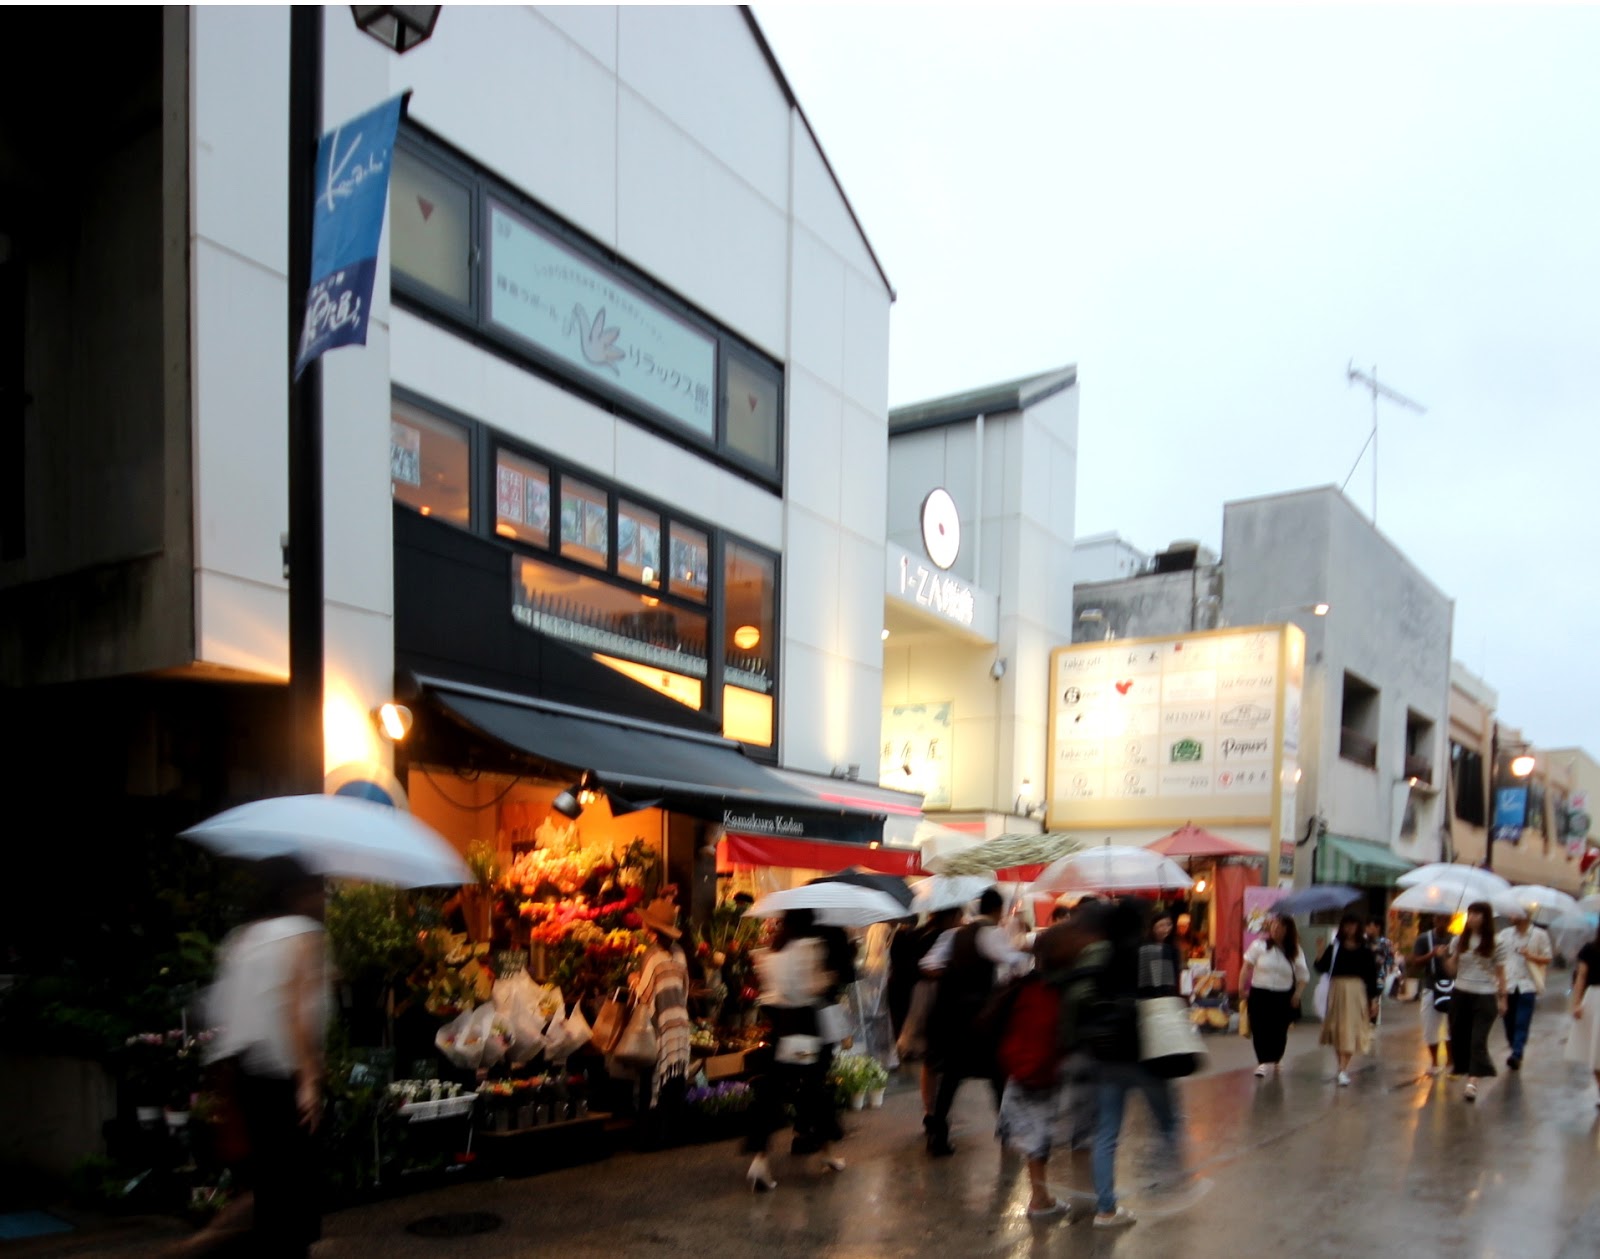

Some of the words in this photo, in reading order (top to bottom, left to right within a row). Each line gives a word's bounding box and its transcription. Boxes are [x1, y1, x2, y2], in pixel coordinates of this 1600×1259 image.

[1221, 738, 1267, 760] Popuri
[723, 809, 775, 832] Kamakura
[775, 815, 804, 835] Kadan
